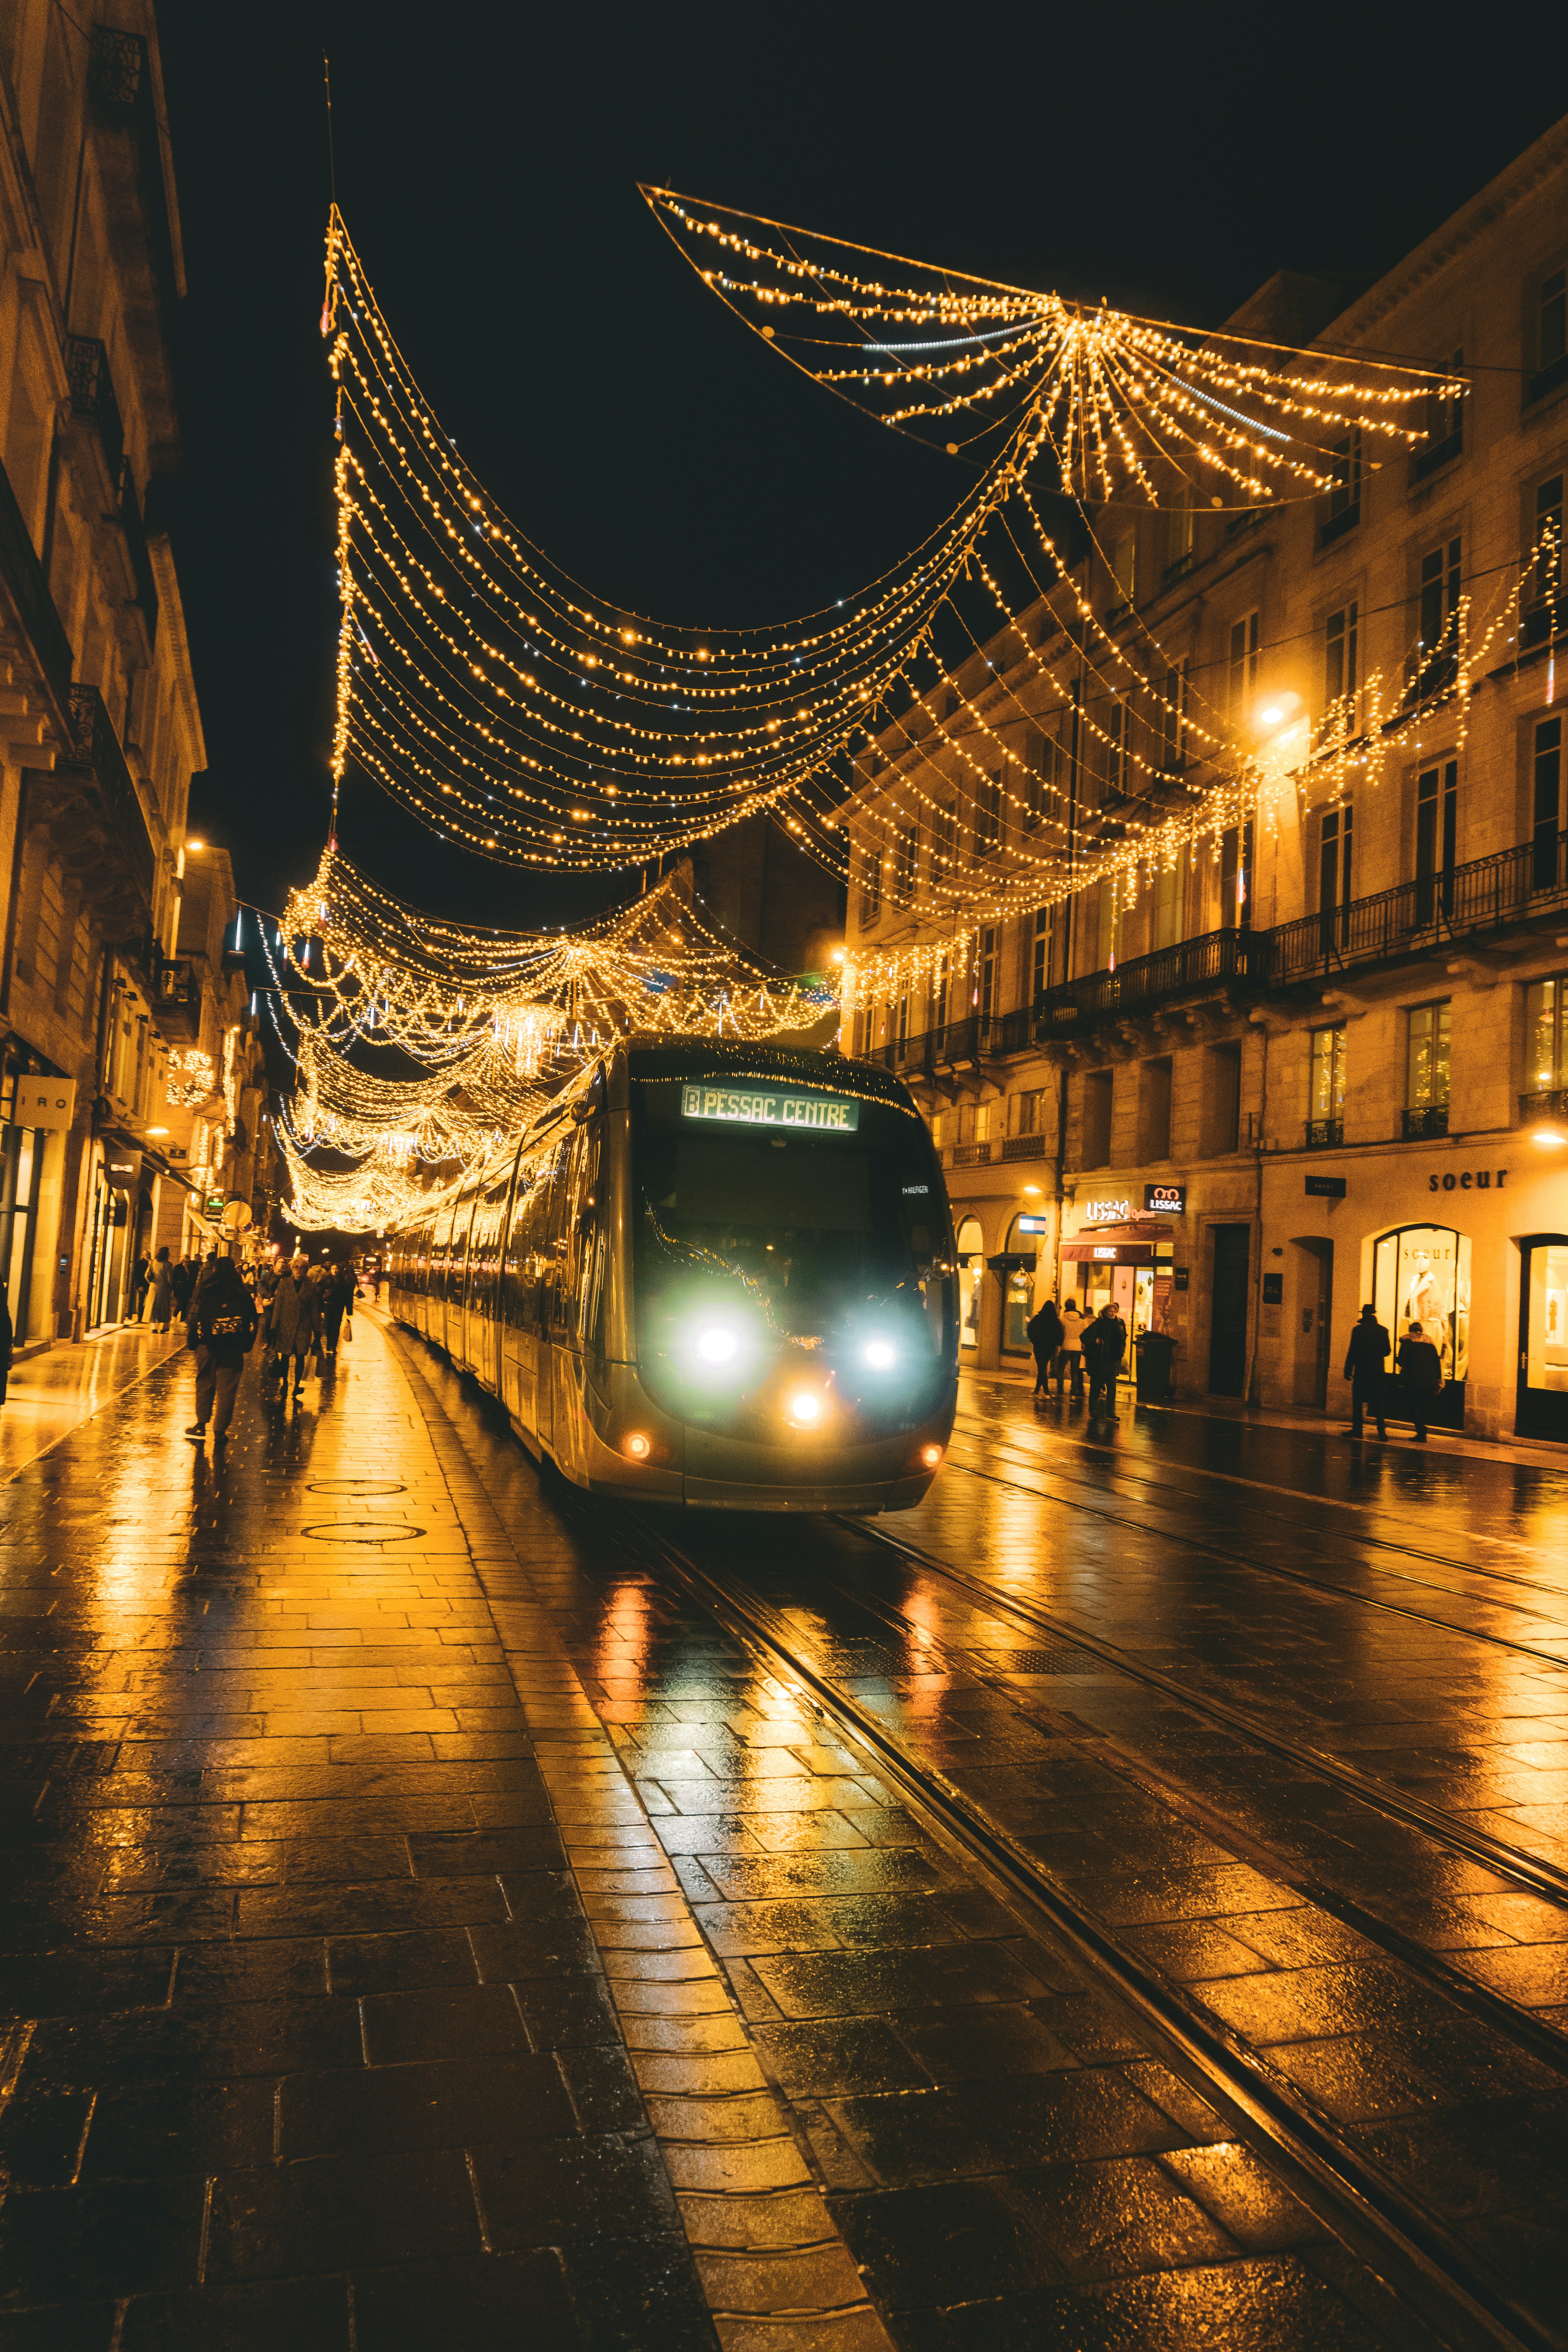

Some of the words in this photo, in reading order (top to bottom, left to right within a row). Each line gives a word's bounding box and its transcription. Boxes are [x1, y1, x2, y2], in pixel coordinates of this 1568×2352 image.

[22, 1096, 66, 1109] IRO
[705, 1092, 776, 1121] PESSAC
[783, 1100, 850, 1128] CENTRE
[1429, 1169, 1508, 1192] soeur
[1086, 1200, 1129, 1221] LISSAC
[1150, 1199, 1182, 1210] LISSAC
[1094, 1247, 1116, 1258] LISSAC
[1404, 1249, 1450, 1259] soeur
